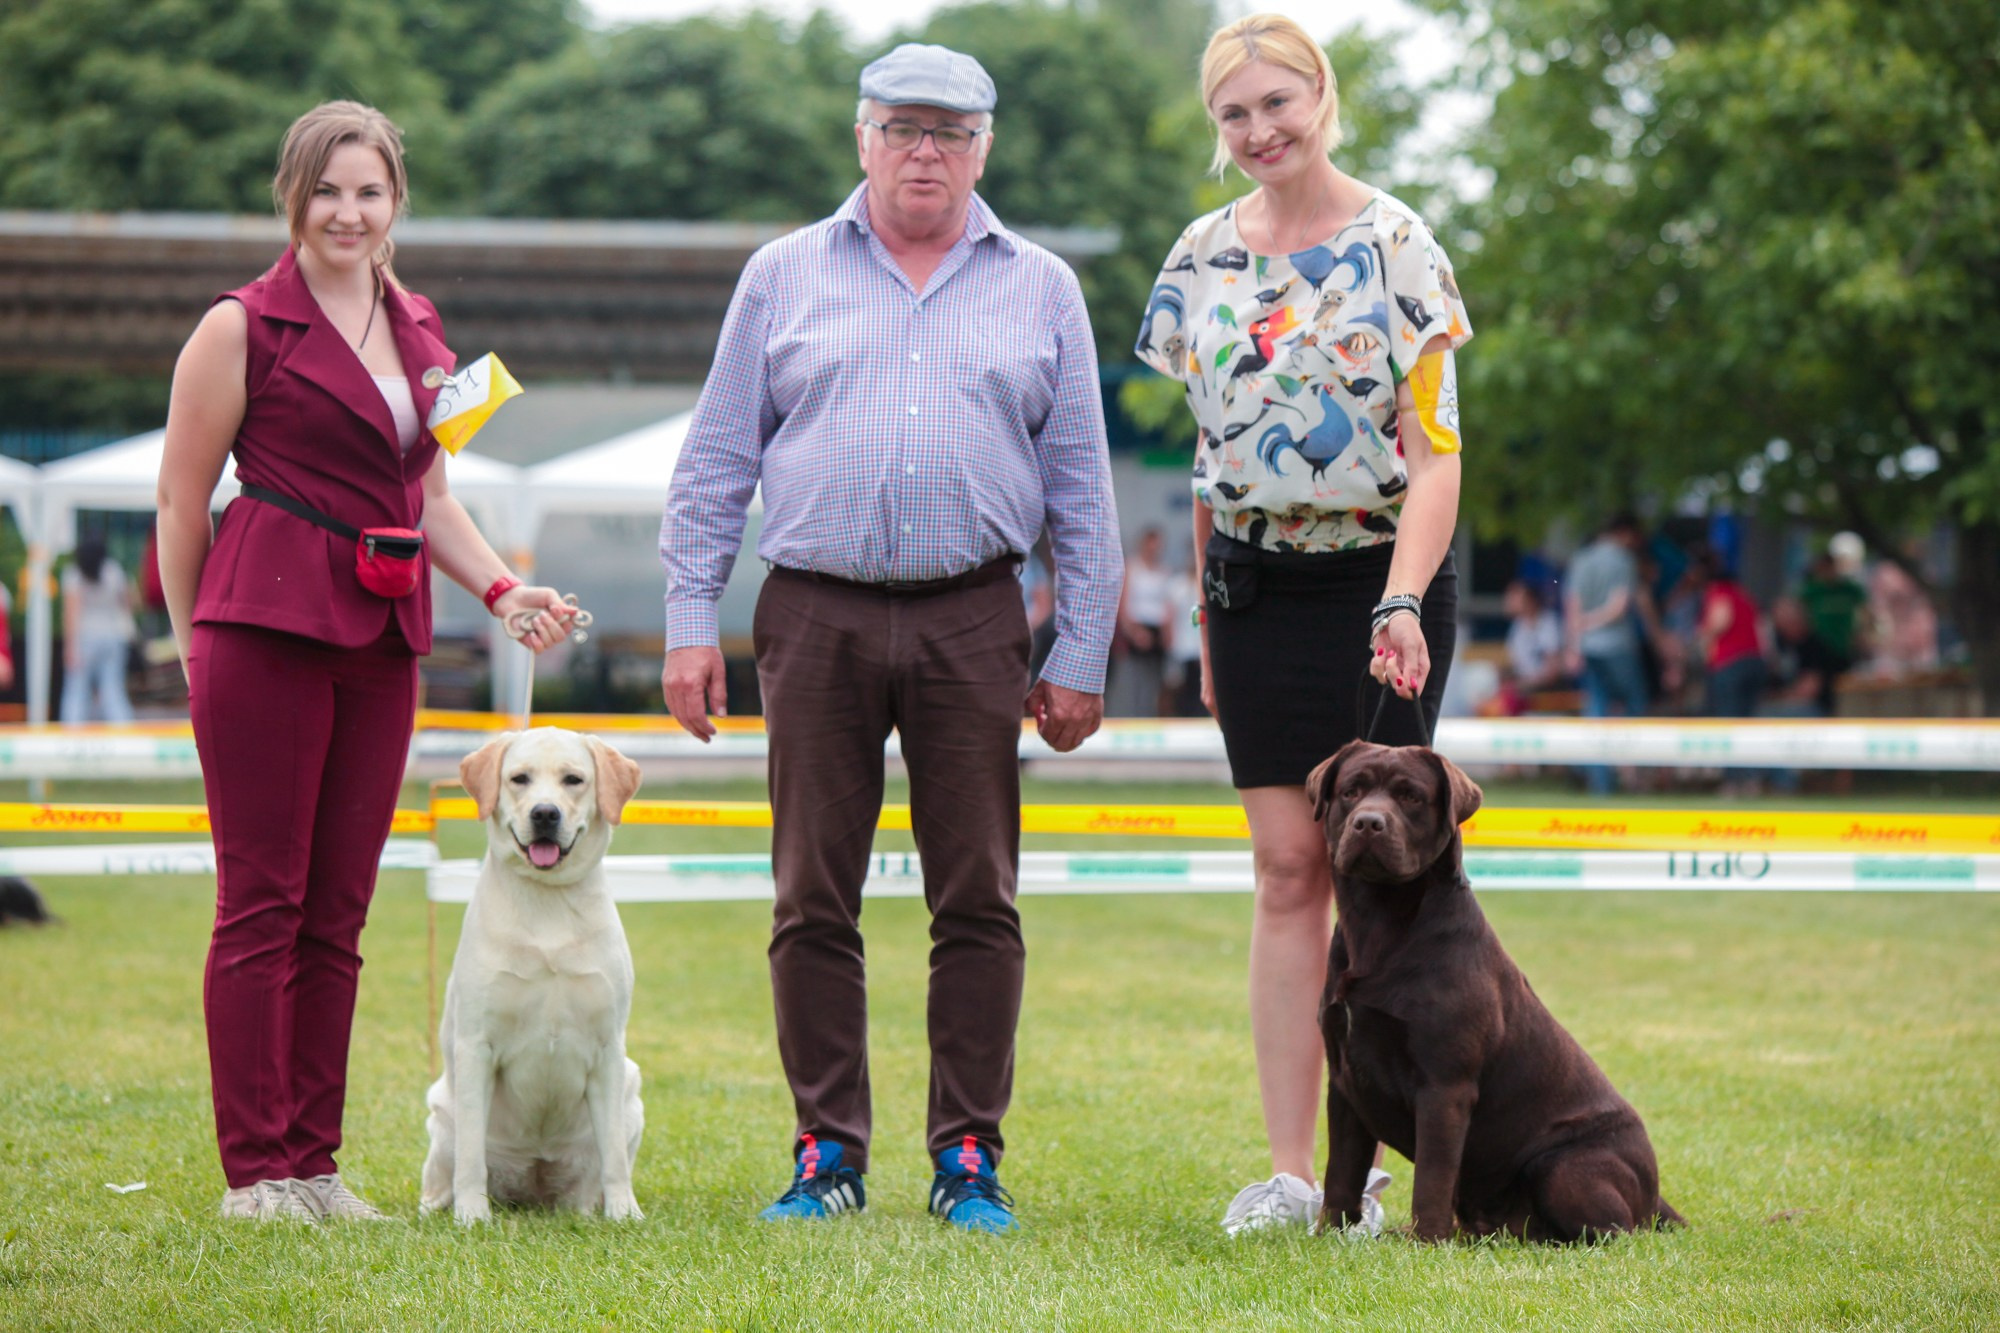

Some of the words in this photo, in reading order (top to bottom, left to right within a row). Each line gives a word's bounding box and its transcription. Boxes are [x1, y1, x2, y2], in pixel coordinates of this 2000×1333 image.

[31, 803, 122, 826] Josera
[1087, 813, 1176, 830] Josera
[1539, 817, 1627, 836] Josera
[1689, 820, 1777, 840] Josera
[1840, 822, 1928, 843] Josera
